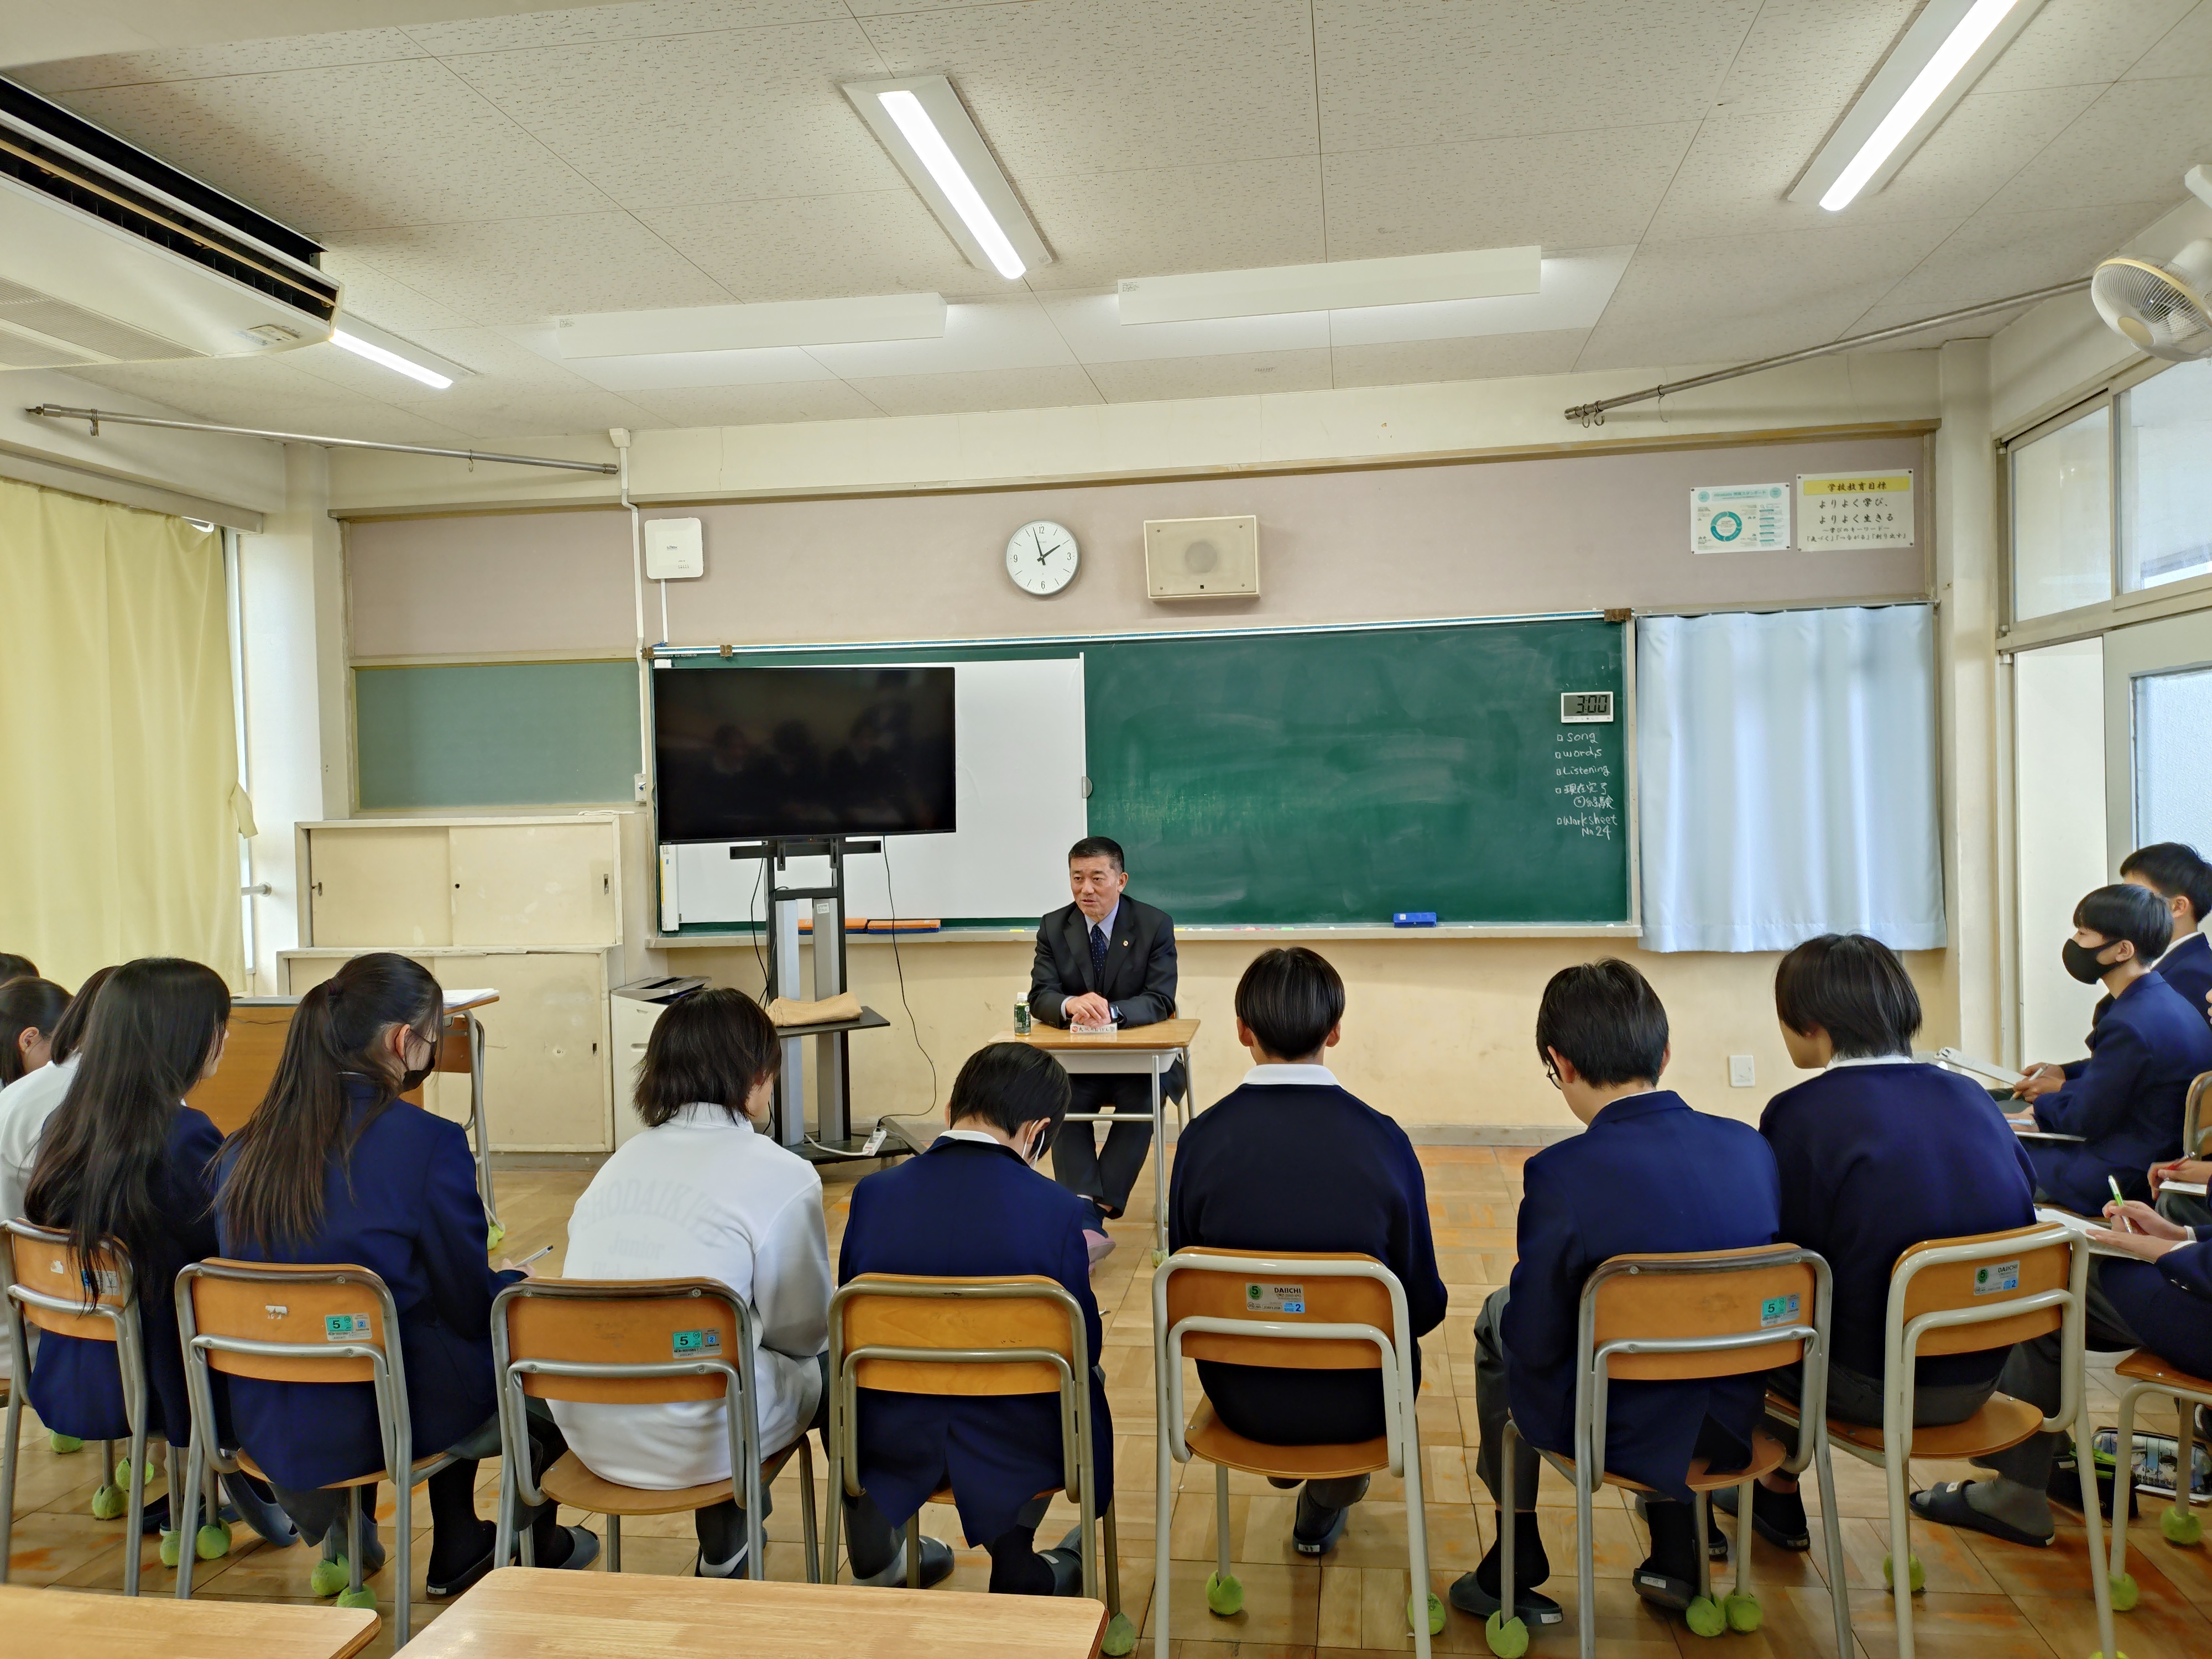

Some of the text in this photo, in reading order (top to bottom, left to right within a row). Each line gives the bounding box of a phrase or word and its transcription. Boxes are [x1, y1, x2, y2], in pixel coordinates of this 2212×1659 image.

[1827, 481, 1887, 492] 学校教育目標
[1819, 497, 1888, 509] よりよく学び、
[1819, 513, 1894, 525] よりよく生きる
[1039, 526, 1045, 534] 12
[1013, 554, 1018, 563] 9
[1067, 552, 1072, 561] 3
[1041, 581, 1045, 589] 6
[1576, 695, 1608, 713] 3:00
[1563, 765, 1610, 777] Listening
[1563, 781, 1608, 795] 現在完了
[2011, 1280, 2016, 1288] 2
[1251, 1286, 1259, 1295] 5
[1295, 1303, 1302, 1312] 2
[1767, 1303, 1775, 1313] 5
[332, 1319, 341, 1329] 5
[680, 1336, 688, 1345] 5
